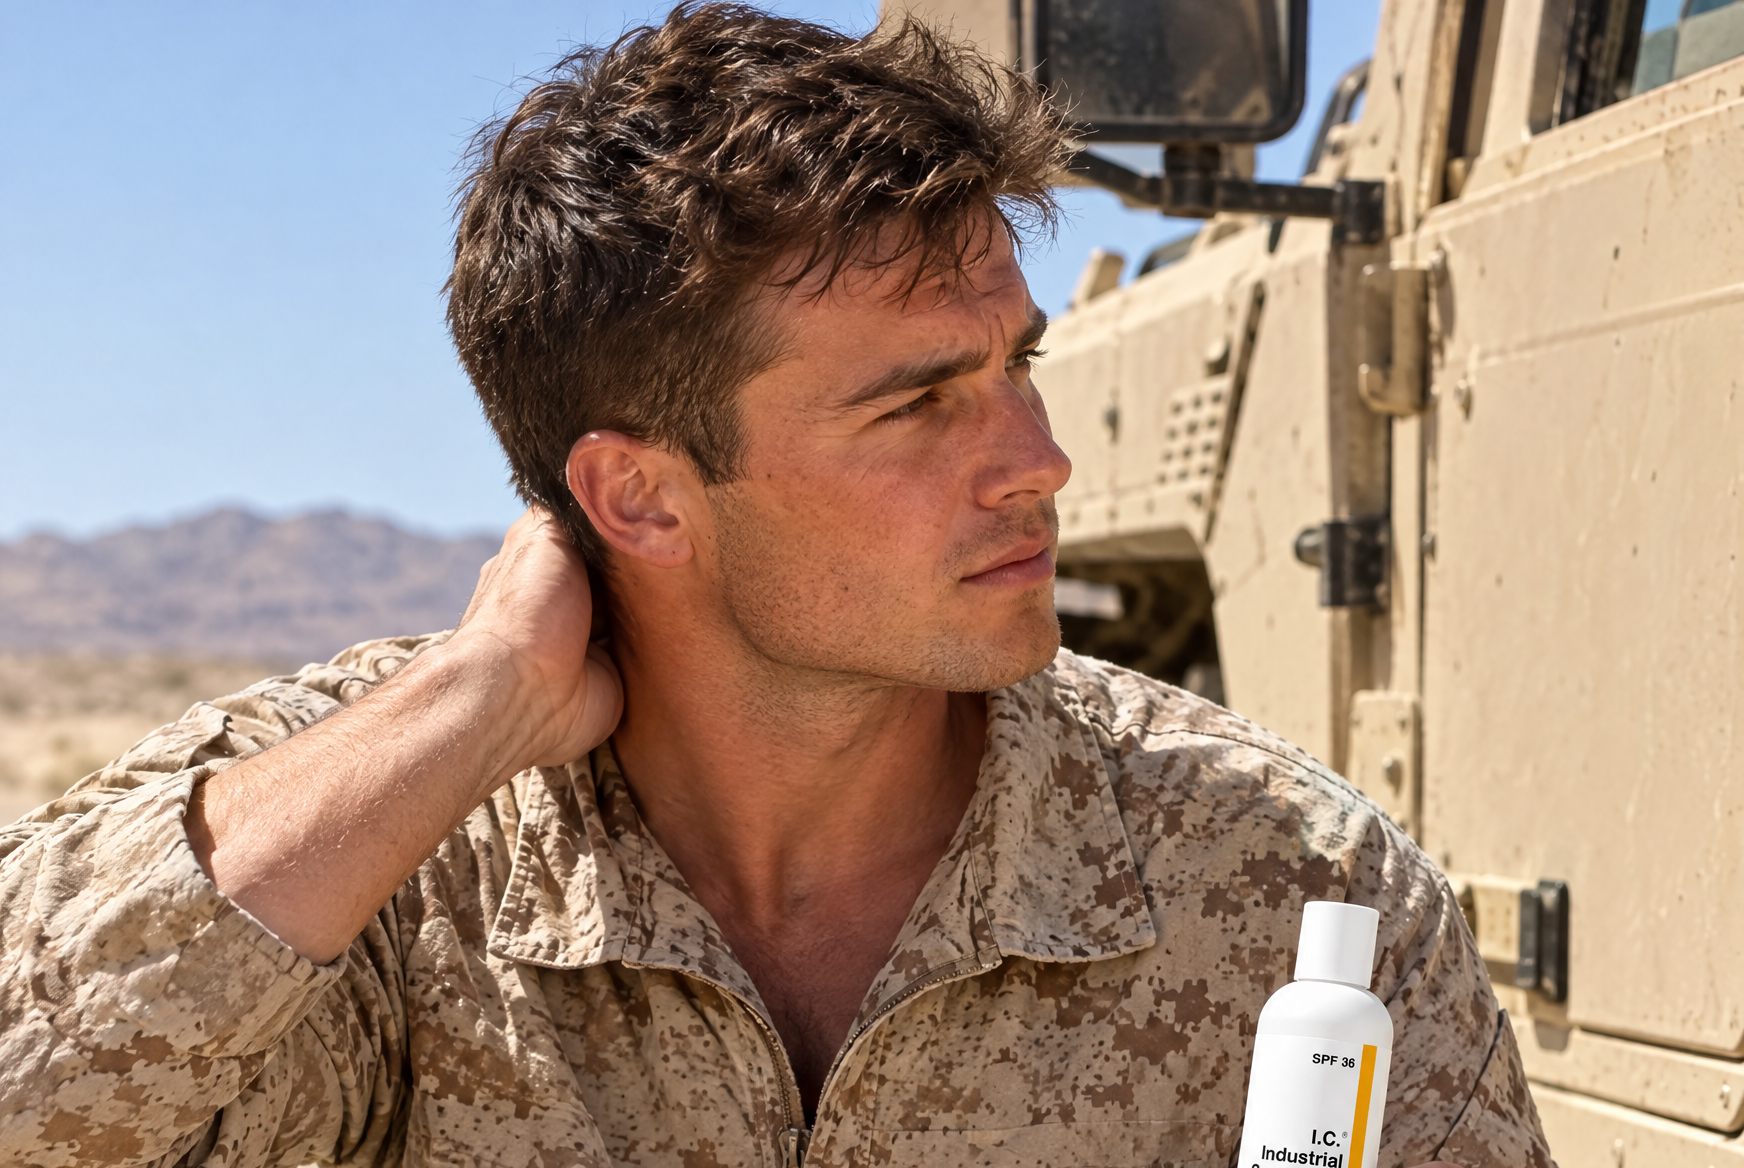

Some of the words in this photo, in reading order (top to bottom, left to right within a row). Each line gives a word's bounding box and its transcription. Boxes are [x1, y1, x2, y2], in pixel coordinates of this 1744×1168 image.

[1312, 1053, 1338, 1066] SPF
[1341, 1057, 1356, 1069] 36
[1261, 1145, 1344, 1168] Industrial
